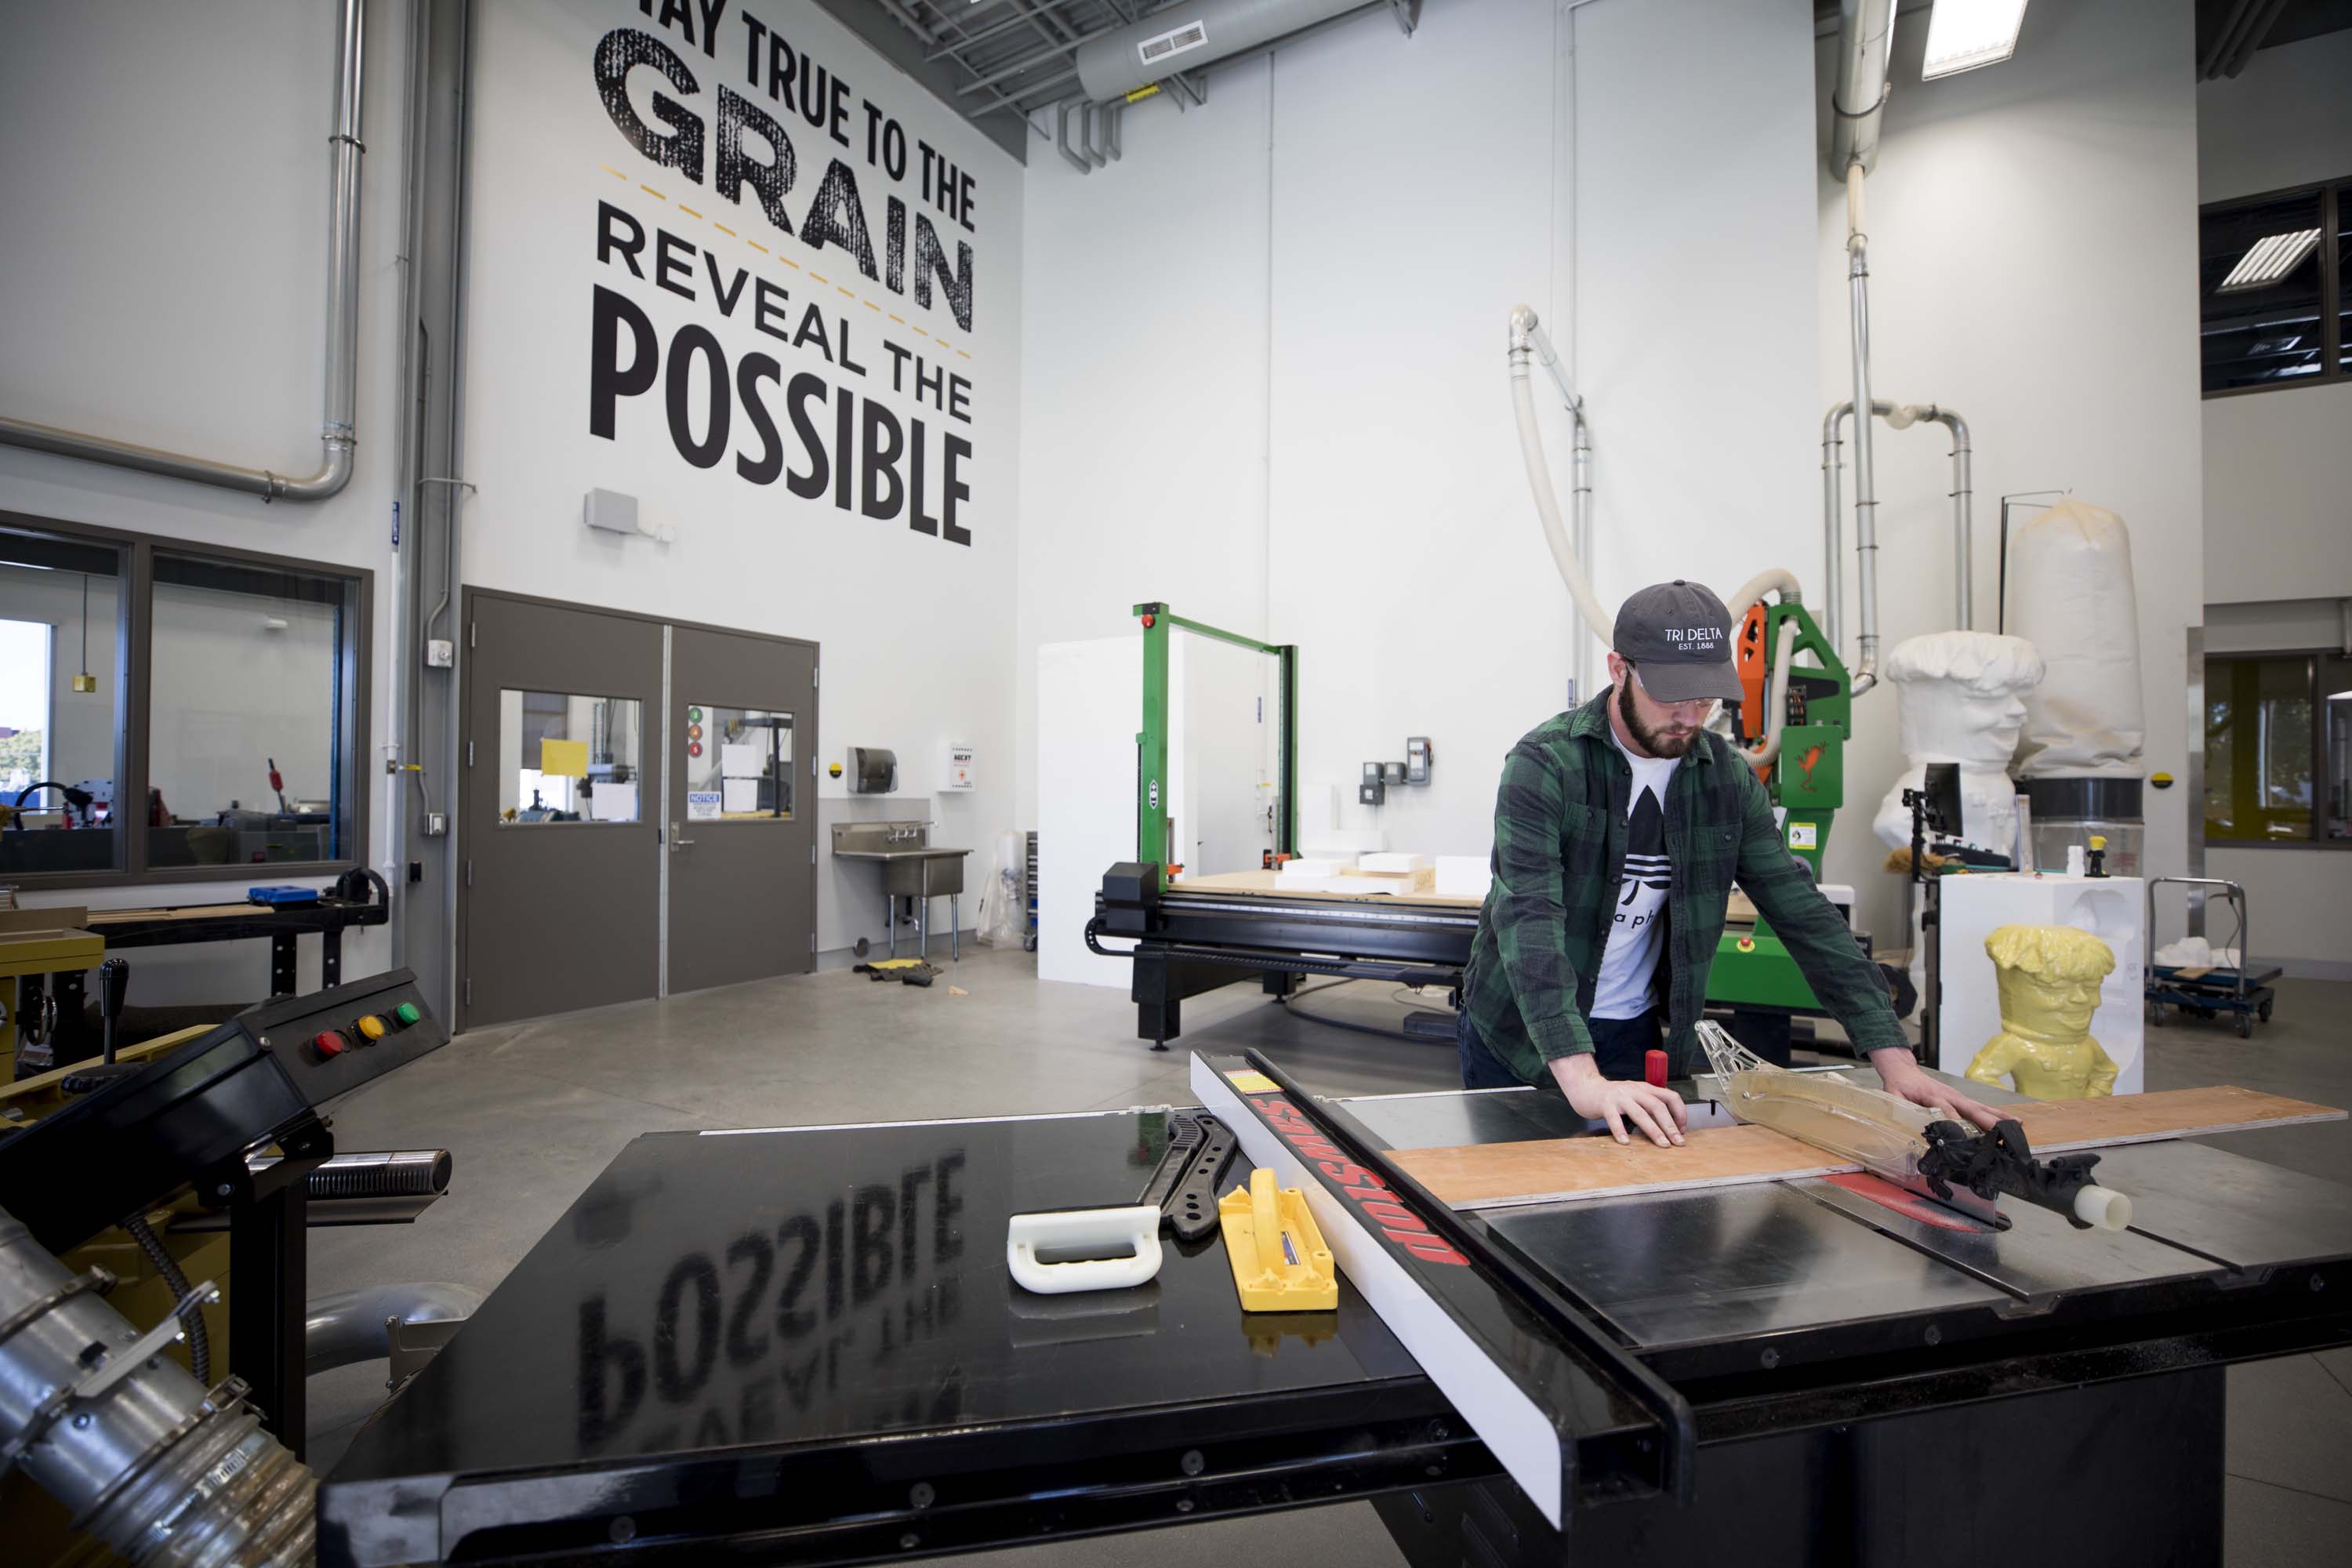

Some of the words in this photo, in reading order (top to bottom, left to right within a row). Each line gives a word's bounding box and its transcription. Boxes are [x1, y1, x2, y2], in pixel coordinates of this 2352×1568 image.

[593, 27, 974, 333] GRAIN
[742, 9, 850, 148] TRUE
[863, 98, 906, 182] TO
[919, 139, 975, 234] THE
[590, 283, 972, 547] POSSIBLE
[597, 199, 866, 377] REVEAL
[884, 339, 972, 424] THE
[1664, 629, 1684, 641] TRI
[1688, 627, 1722, 641] DELTA
[1250, 1098, 1471, 1267] SAWSTOP
